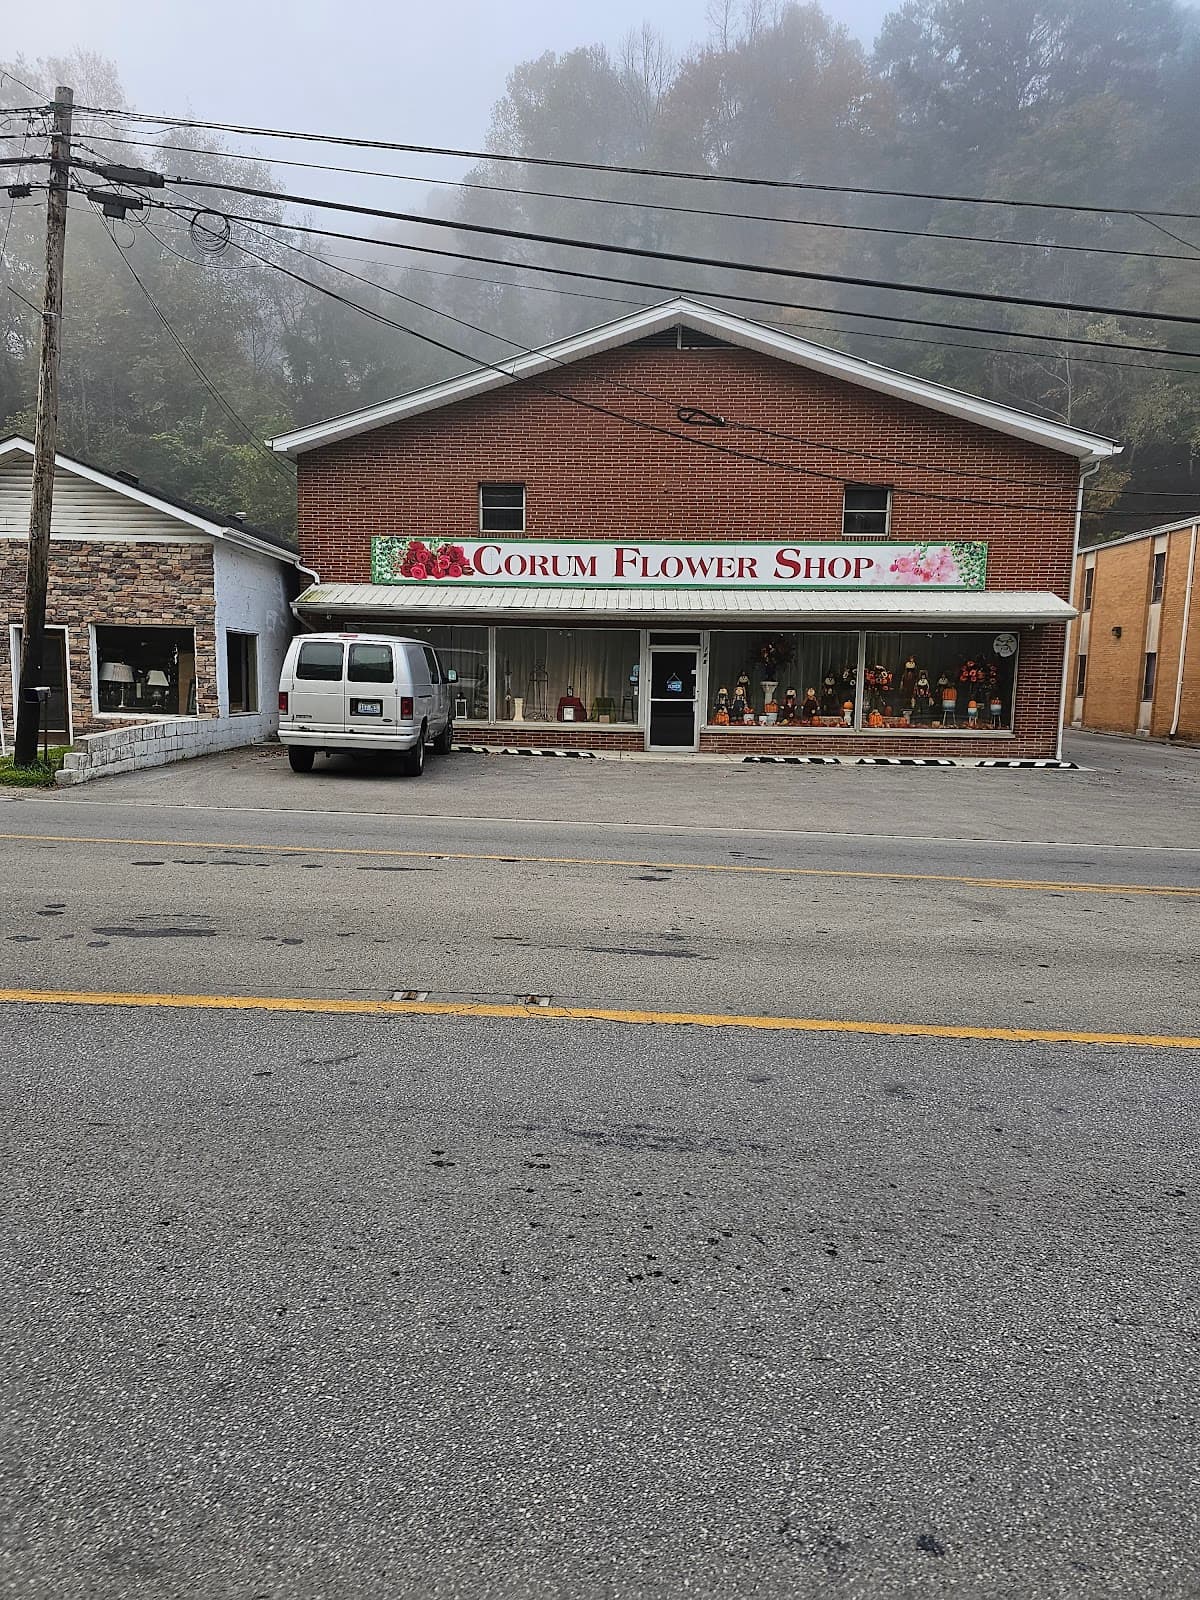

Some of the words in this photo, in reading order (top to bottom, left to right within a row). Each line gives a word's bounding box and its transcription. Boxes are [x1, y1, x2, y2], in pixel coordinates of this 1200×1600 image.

[473, 545, 598, 577] CORUM
[613, 547, 758, 579] FLOWER
[773, 548, 874, 579] SHOP
